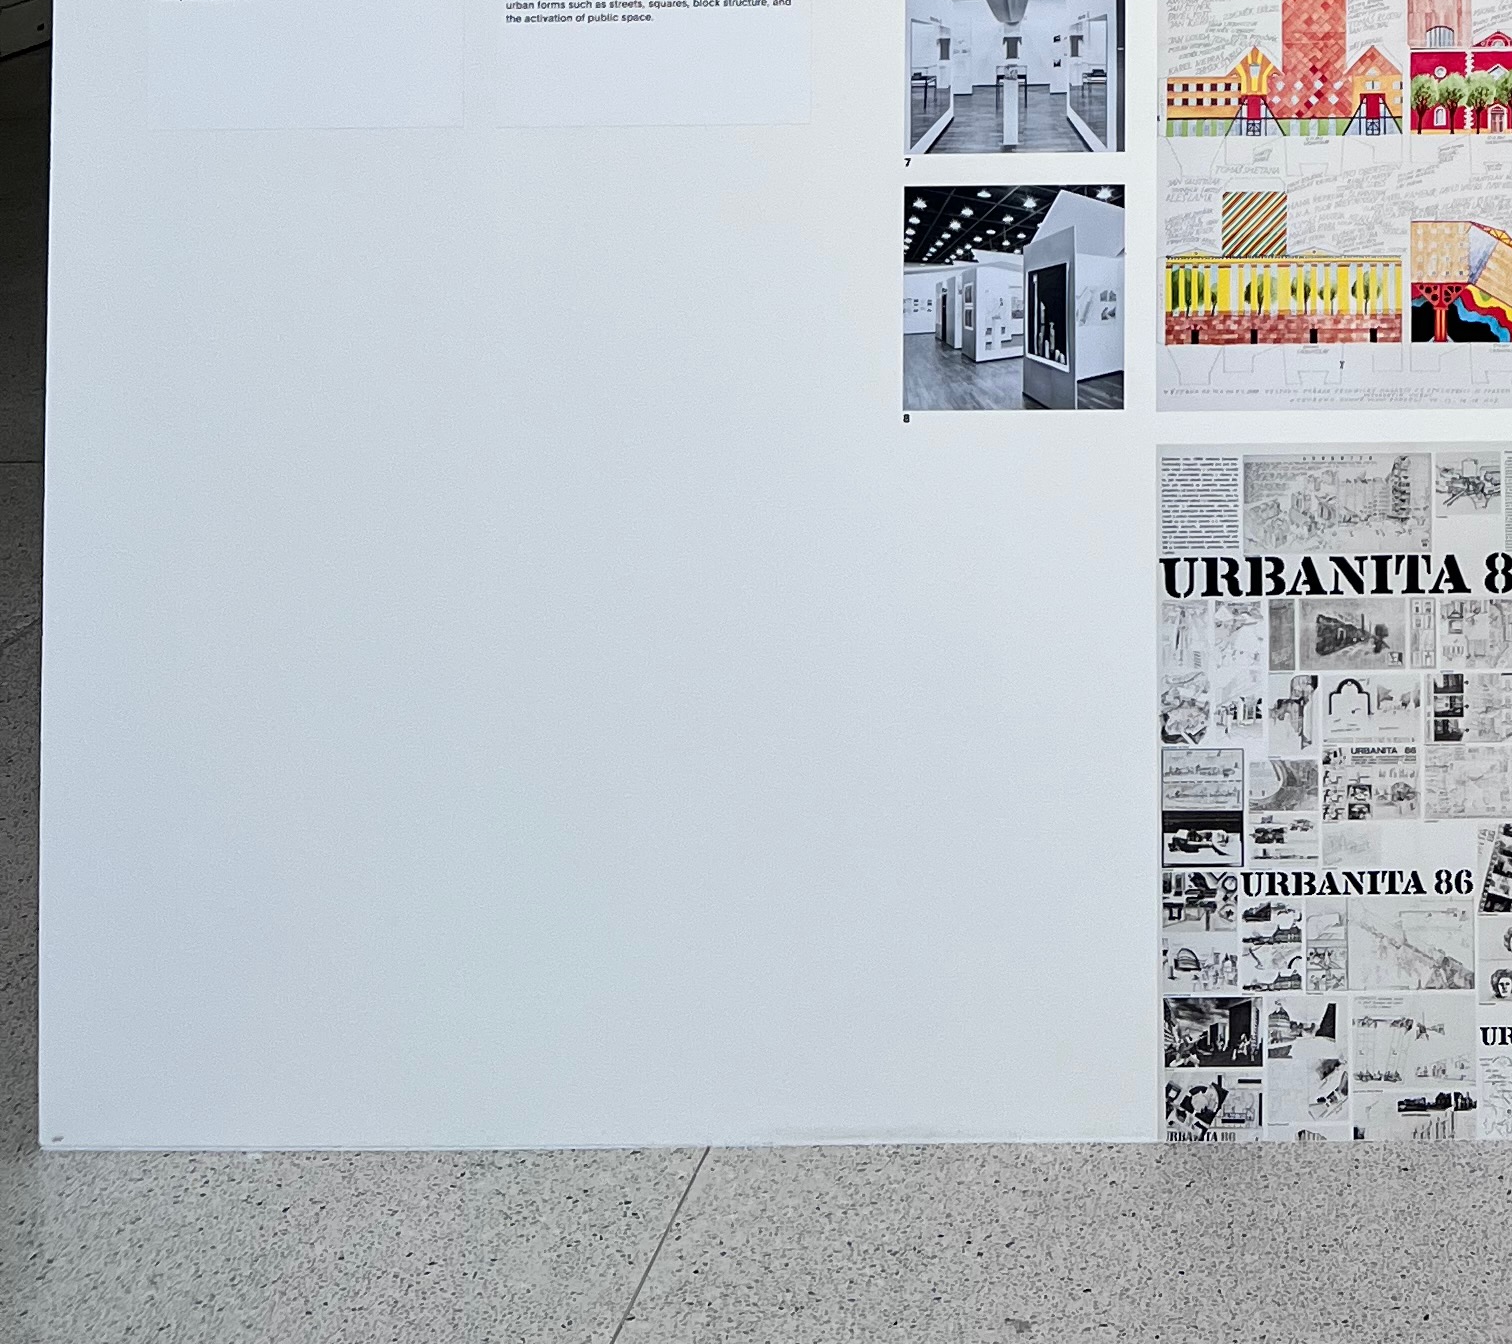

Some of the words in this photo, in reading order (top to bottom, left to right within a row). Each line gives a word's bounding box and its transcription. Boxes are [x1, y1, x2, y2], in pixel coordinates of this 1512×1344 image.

[905, 158, 911, 166] 7
[903, 414, 909, 423] 8
[1158, 553, 1471, 598] URBANITA
[1239, 870, 1427, 897] URBANITA
[1434, 869, 1473, 894] 86
